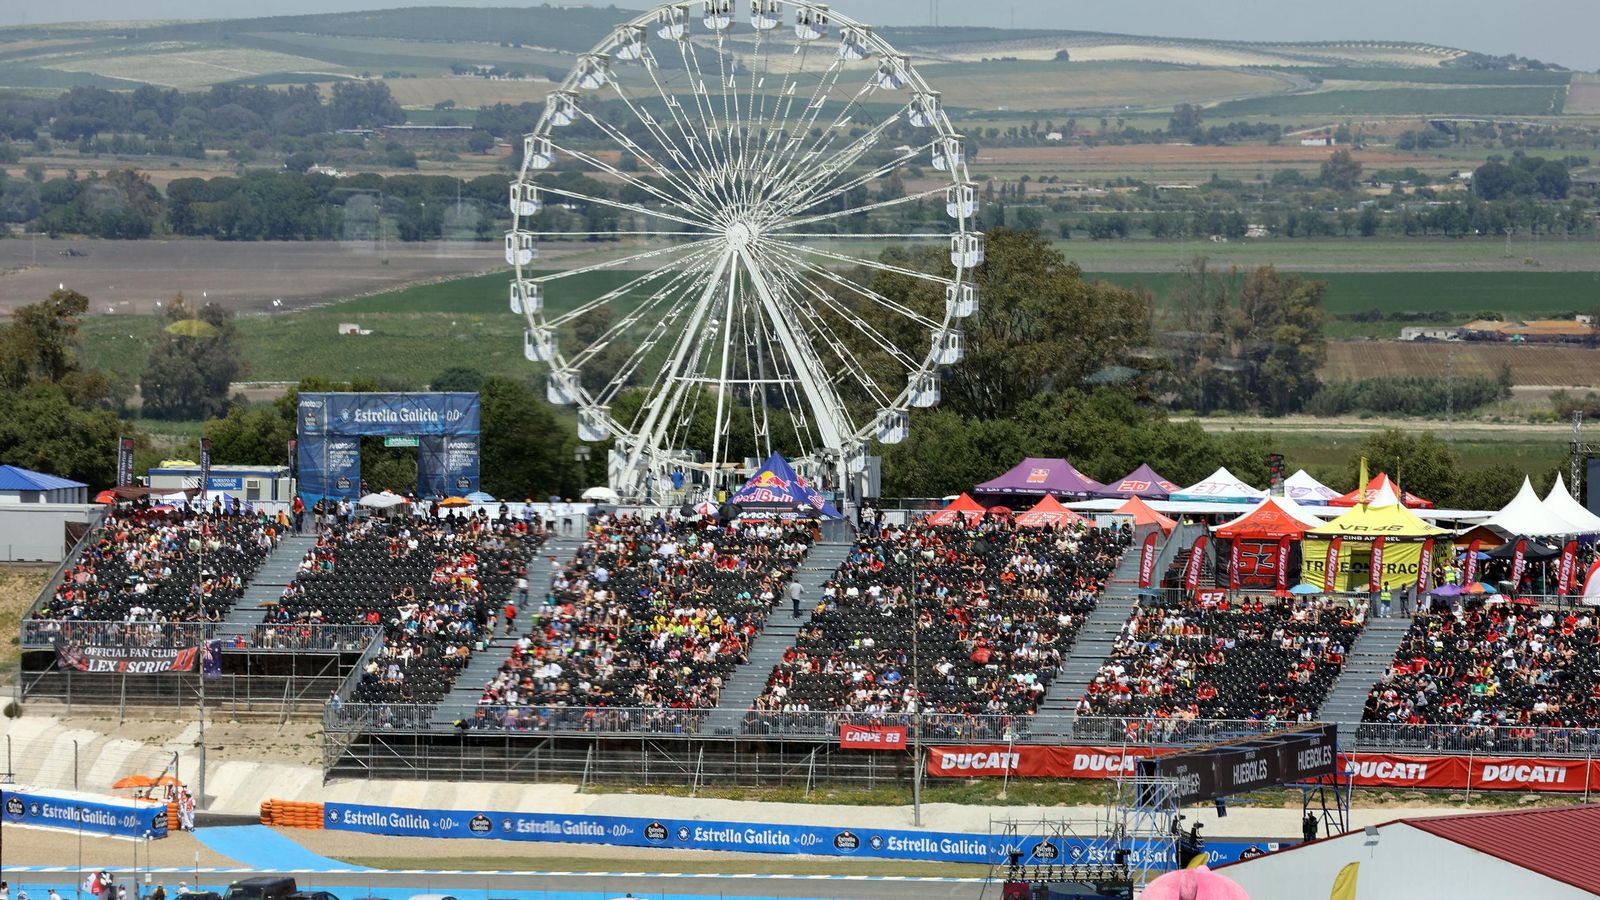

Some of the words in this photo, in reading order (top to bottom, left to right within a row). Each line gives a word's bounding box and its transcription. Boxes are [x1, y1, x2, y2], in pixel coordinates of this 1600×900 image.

[355, 408, 397, 422] Estrella
[400, 408, 438, 422] Galicia
[760, 488, 793, 502] Bull
[1143, 544, 1154, 582] DUCATI
[1189, 547, 1202, 585] DUCATI
[1232, 546, 1240, 584] DUCATI
[1328, 548, 1337, 586] DUCATI
[1372, 548, 1382, 586] DUCATI
[1420, 550, 1430, 588] DUCATI
[1559, 552, 1572, 590] DUCATI
[85, 647, 128, 658] OFFICIAL
[130, 648, 149, 658] FAN
[152, 648, 178, 658] CLUB
[118, 660, 171, 672] ESCRIG
[846, 732, 881, 742] CARPE
[941, 752, 1020, 769] DUCATI
[1073, 754, 1134, 771] DUCA
[1344, 761, 1428, 780] DUCATI
[1482, 764, 1566, 783] DUCATI
[42, 803, 80, 821] Estrella
[81, 810, 116, 826] Galicia
[344, 810, 387, 827] Estrella
[389, 813, 430, 830] Galicia
[517, 819, 561, 834] Estrella
[562, 820, 605, 836] Galicia
[694, 828, 742, 843] Estrella
[744, 829, 790, 846] Galicia
[887, 836, 938, 853] Estrella
[941, 838, 986, 856] Galicia
